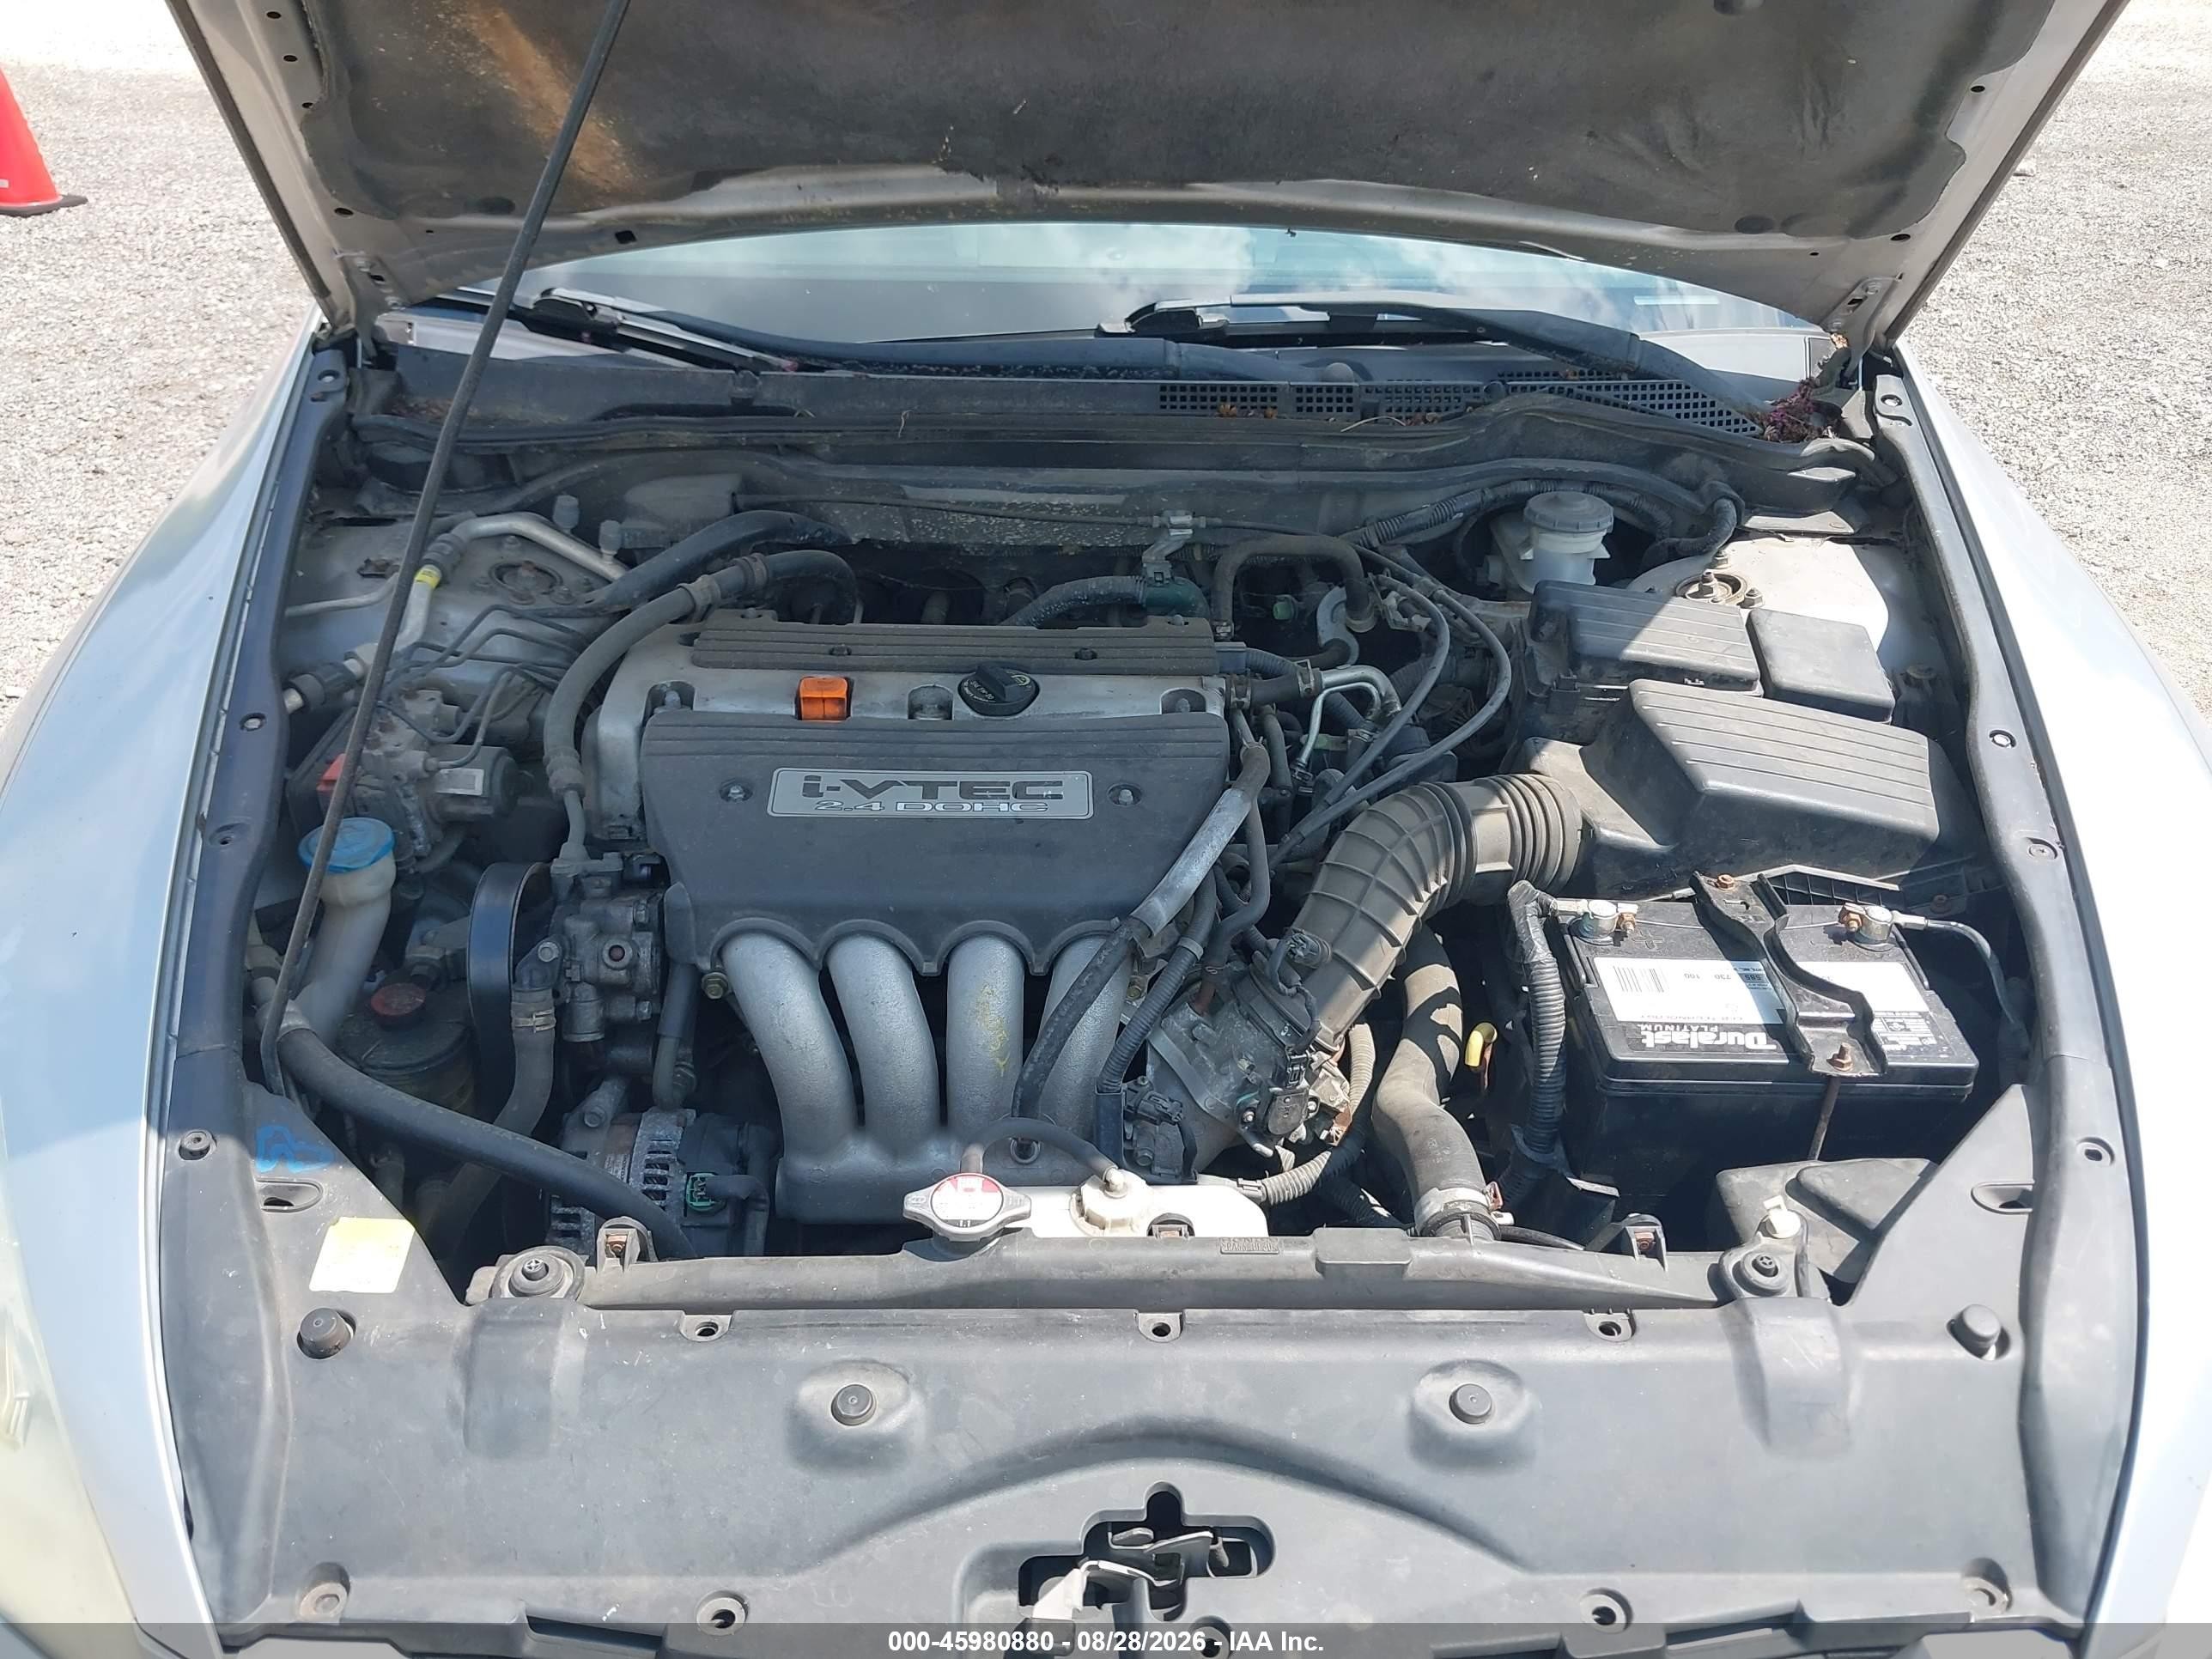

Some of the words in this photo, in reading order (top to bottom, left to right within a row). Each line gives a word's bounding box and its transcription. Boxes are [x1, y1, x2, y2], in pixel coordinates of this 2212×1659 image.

[802, 775, 1064, 800] i-VTEC
[815, 800, 884, 812] 2.4
[895, 801, 1048, 813] DOHC
[1642, 1024, 1718, 1032] PLATINUM
[1641, 1030, 1777, 1050] Duralast
